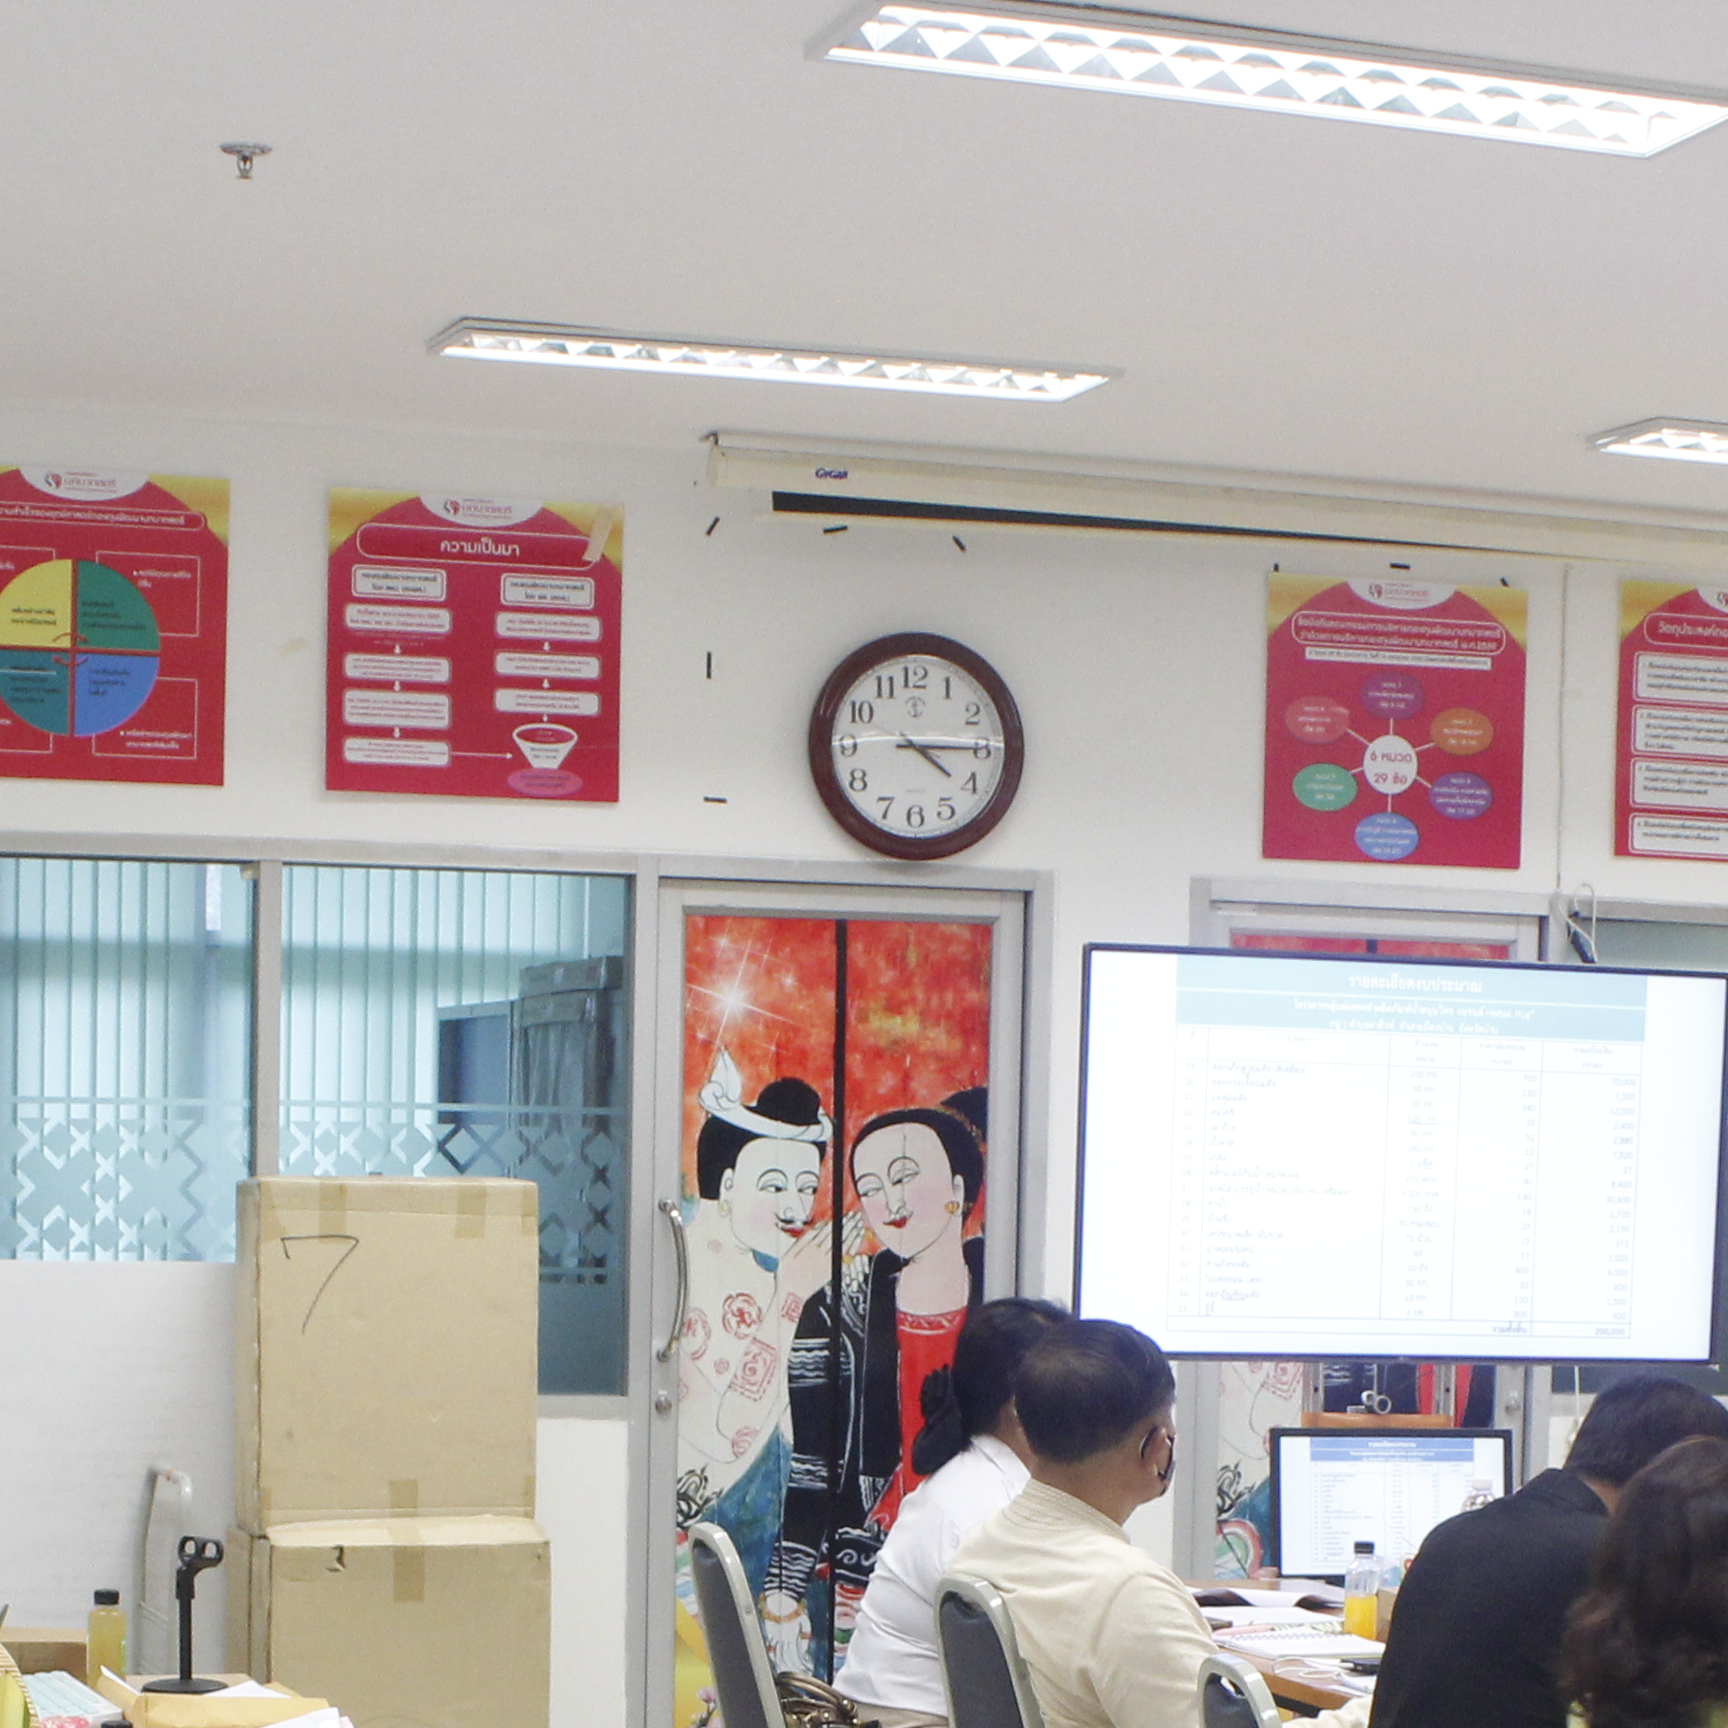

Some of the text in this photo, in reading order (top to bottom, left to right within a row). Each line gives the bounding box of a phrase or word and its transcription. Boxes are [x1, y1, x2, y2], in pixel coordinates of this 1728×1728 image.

[440, 536, 520, 557] ความเป็นมา
[875, 675, 896, 699] 11
[901, 666, 928, 690] 12
[942, 676, 952, 699] 1
[849, 700, 873, 725] 10
[965, 702, 981, 726] 2
[839, 735, 858, 758] 9
[1370, 751, 1413, 764] 6 หมวด
[849, 768, 868, 792] 8
[959, 771, 978, 795] 4
[1373, 772, 1408, 786] 29 ข้อ
[876, 795, 894, 821] 7
[906, 805, 925, 829] 6
[937, 797, 956, 822] 5
[1349, 974, 1482, 993] รายละเอียดงบประมาณ
[1594, 1327, 1625, 1336] 200,000
